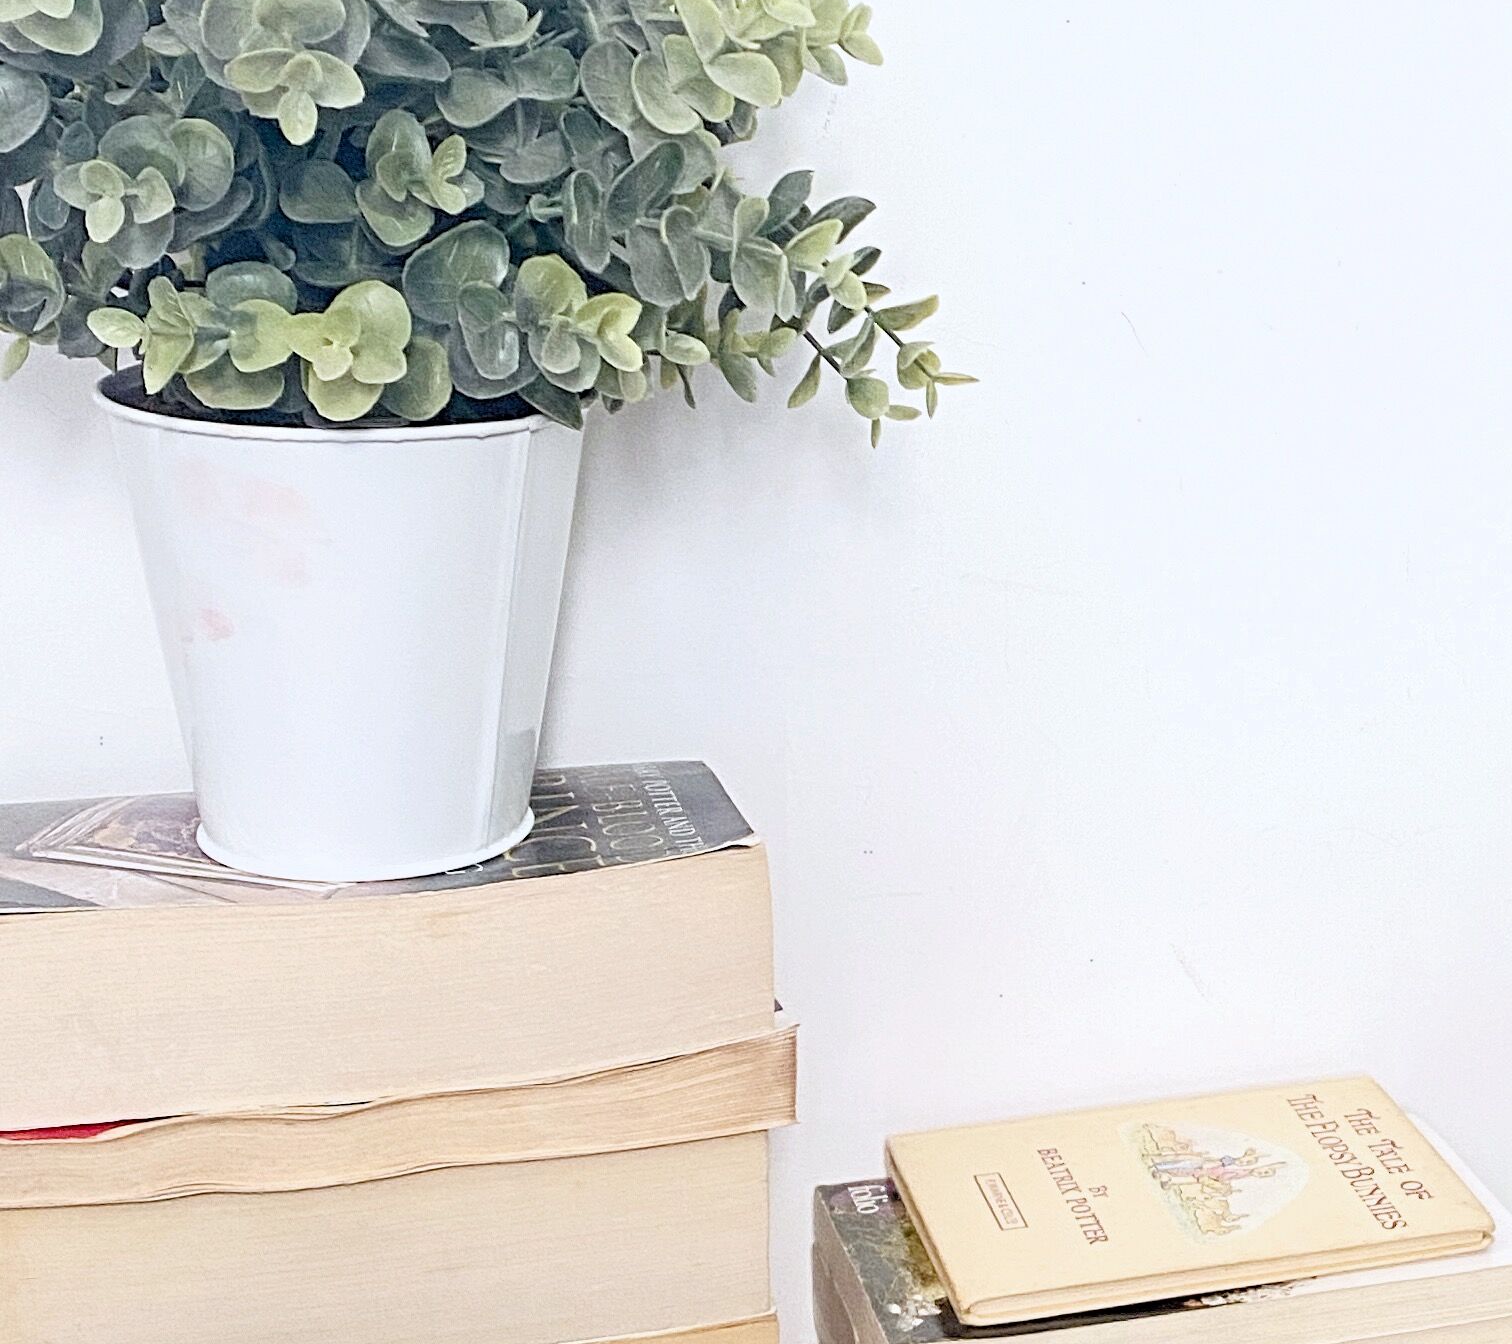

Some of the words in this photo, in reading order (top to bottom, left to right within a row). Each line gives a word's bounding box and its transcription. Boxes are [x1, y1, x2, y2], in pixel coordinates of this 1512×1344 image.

[661, 814, 695, 837] AND
[1286, 1093, 1325, 1122] THE
[1305, 1120, 1362, 1166] FLOPSY
[1344, 1108, 1381, 1136] THE
[1367, 1138, 1414, 1175] TALE
[1400, 1180, 1435, 1200] OF
[847, 1184, 889, 1214] folio
[1037, 1148, 1082, 1195] BEATRIX
[1066, 1197, 1109, 1245] POTTER
[1088, 1185, 1109, 1198] BY
[1340, 1166, 1409, 1231] BUNNIES
